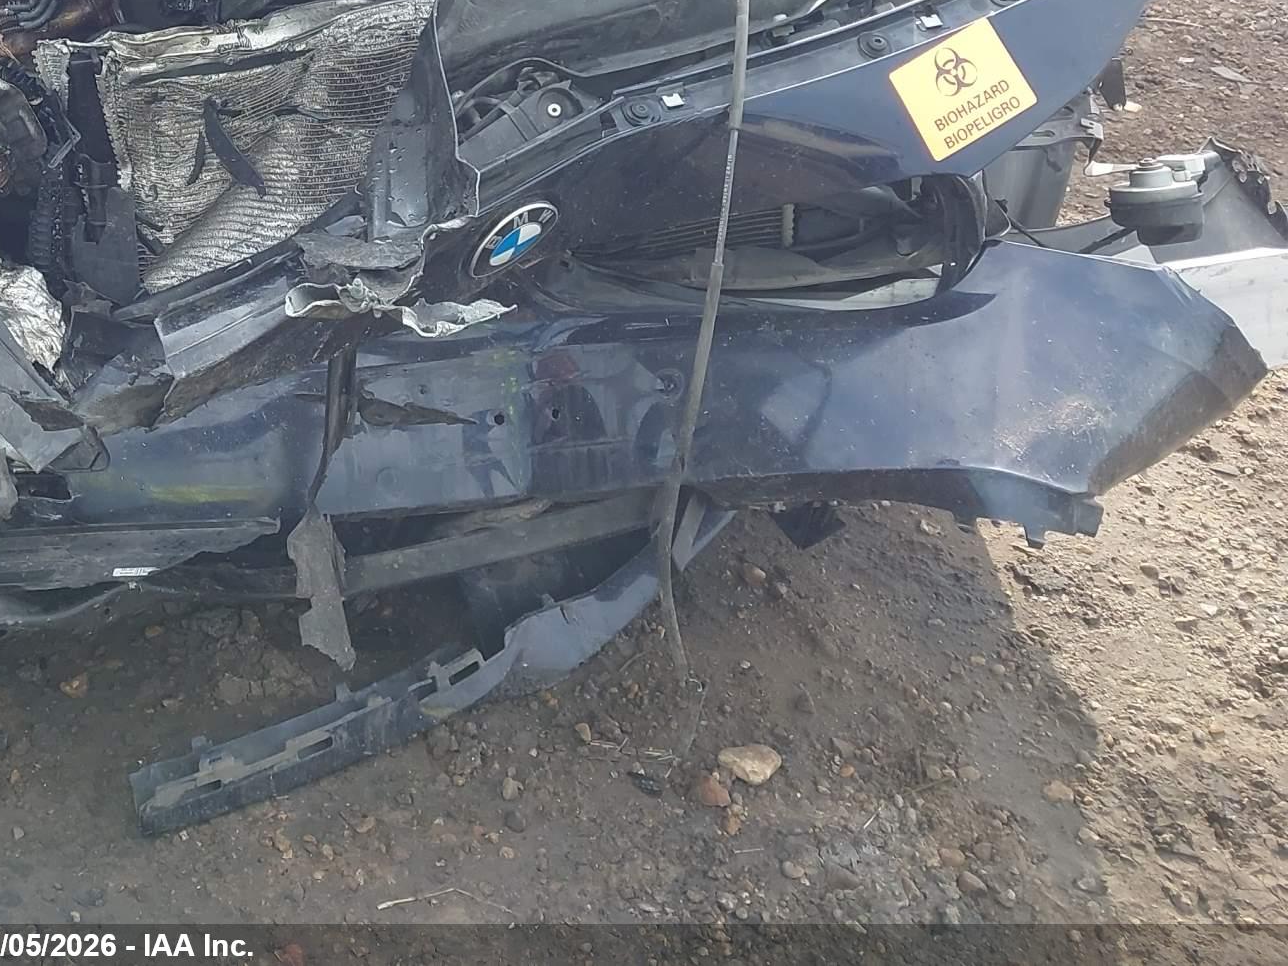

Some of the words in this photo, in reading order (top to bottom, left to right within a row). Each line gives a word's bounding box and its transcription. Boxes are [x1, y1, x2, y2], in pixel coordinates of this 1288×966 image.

[933, 79, 1010, 132] BIOHAZARD
[943, 96, 1021, 150] BIOPELIGRO
[484, 208, 555, 250] BMW
